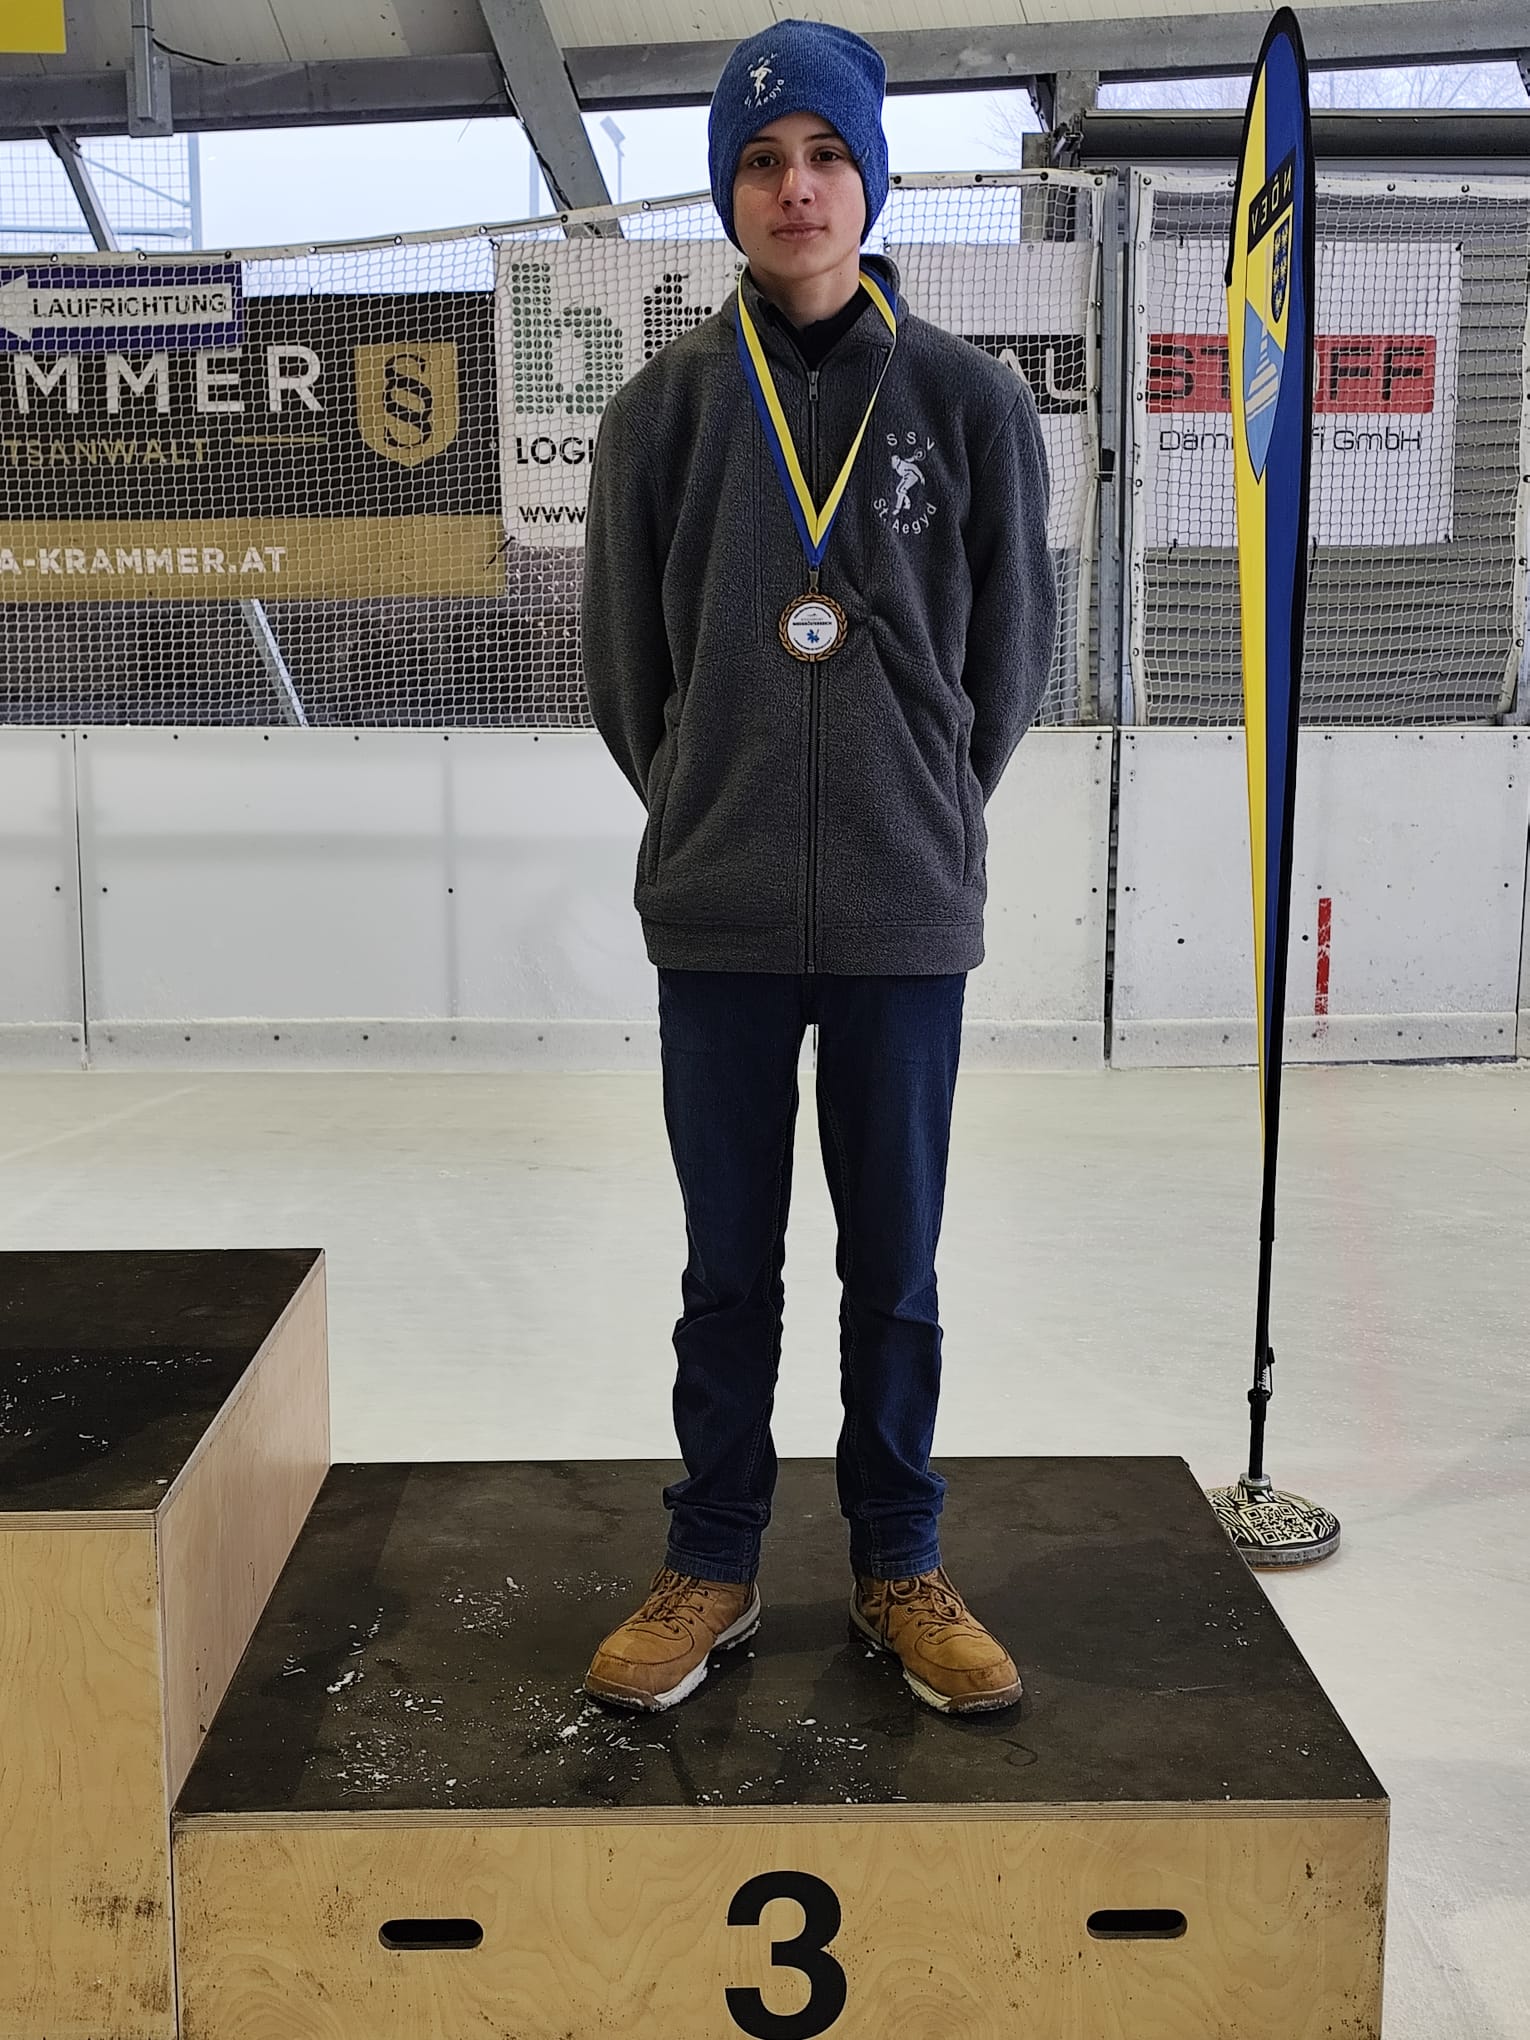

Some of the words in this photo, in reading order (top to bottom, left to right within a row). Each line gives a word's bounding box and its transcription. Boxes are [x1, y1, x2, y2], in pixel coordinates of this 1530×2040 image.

[33, 292, 227, 318] LAUFRICHTUNG
[13, 345, 324, 414] MMER
[3, 438, 207, 466] TSANWALT
[886, 431, 935, 451] SSV
[1333, 426, 1421, 450] GmbH
[892, 502, 937, 534] Aegyd
[0, 546, 286, 575] A-KRAMMER.AT
[724, 1870, 847, 2040] 3
